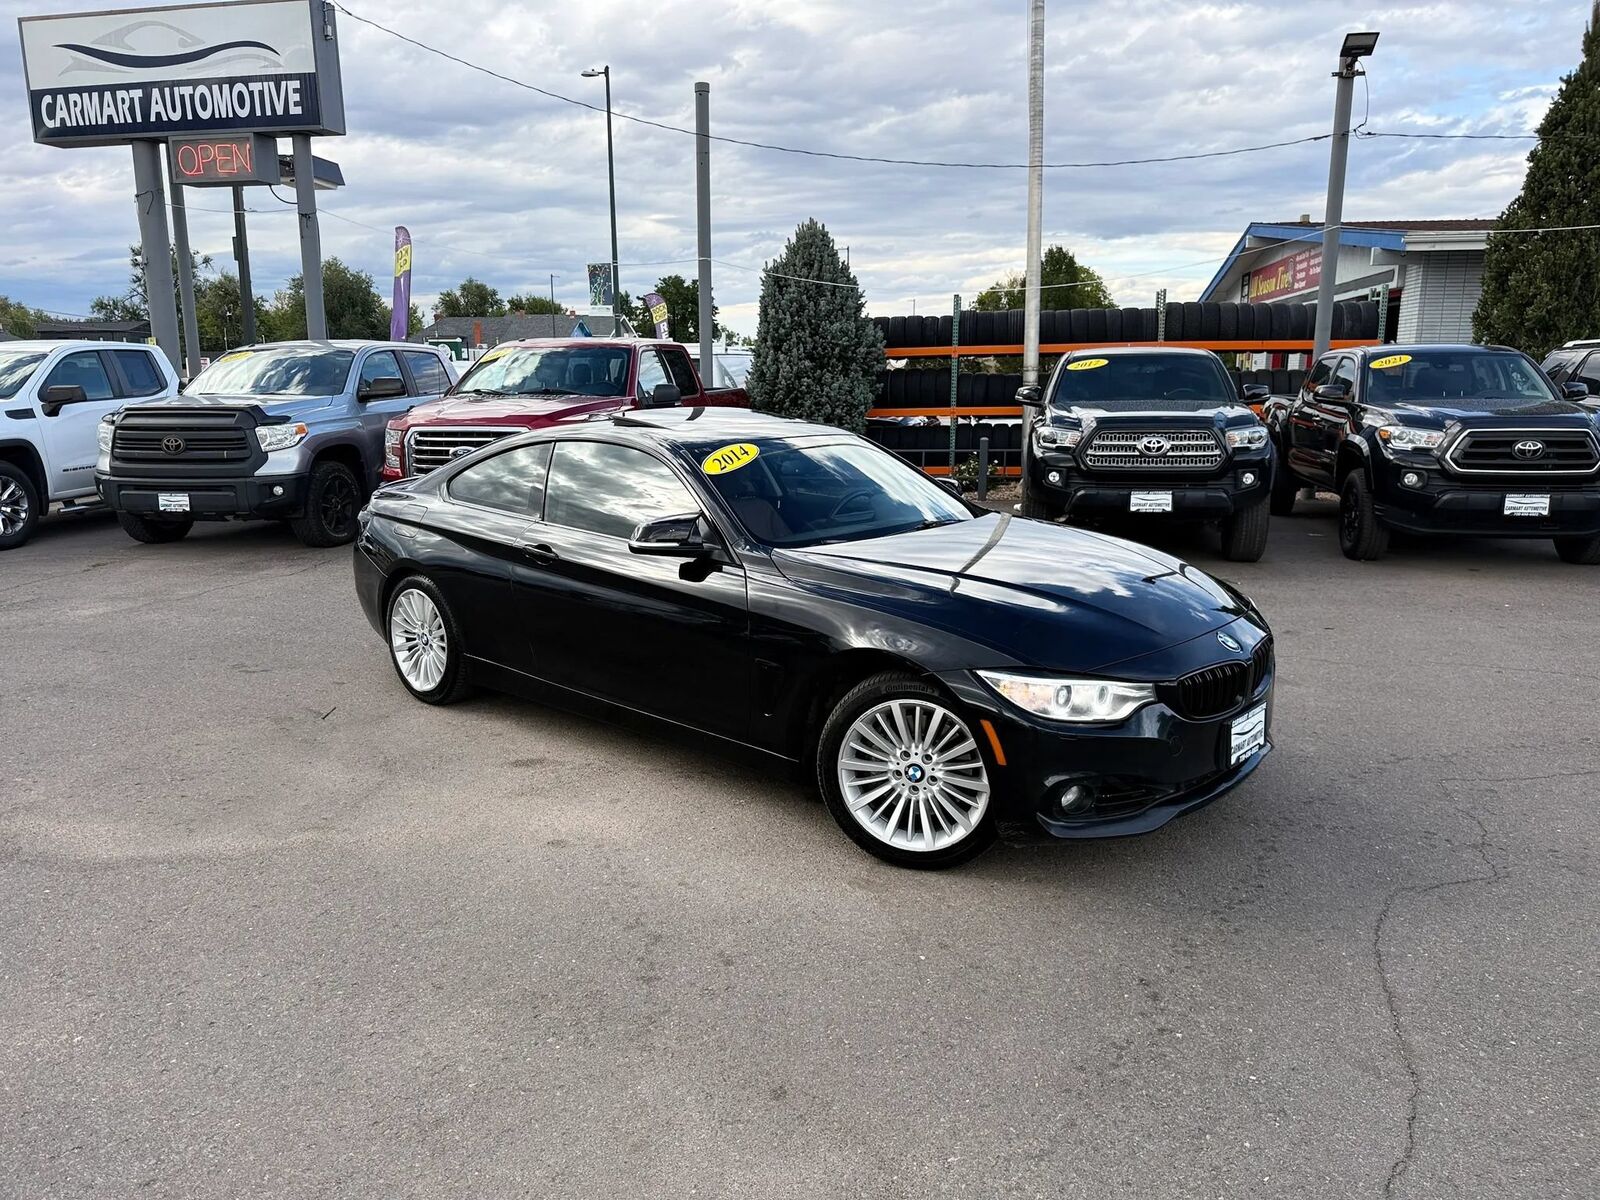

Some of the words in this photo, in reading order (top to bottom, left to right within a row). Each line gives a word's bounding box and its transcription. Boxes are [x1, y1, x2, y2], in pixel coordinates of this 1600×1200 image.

[41, 88, 143, 129] CARMART
[150, 79, 303, 122] AUTOMOTIVE
[177, 143, 252, 176] OPEN
[1378, 356, 1402, 367] 2021
[712, 445, 750, 471] 2014
